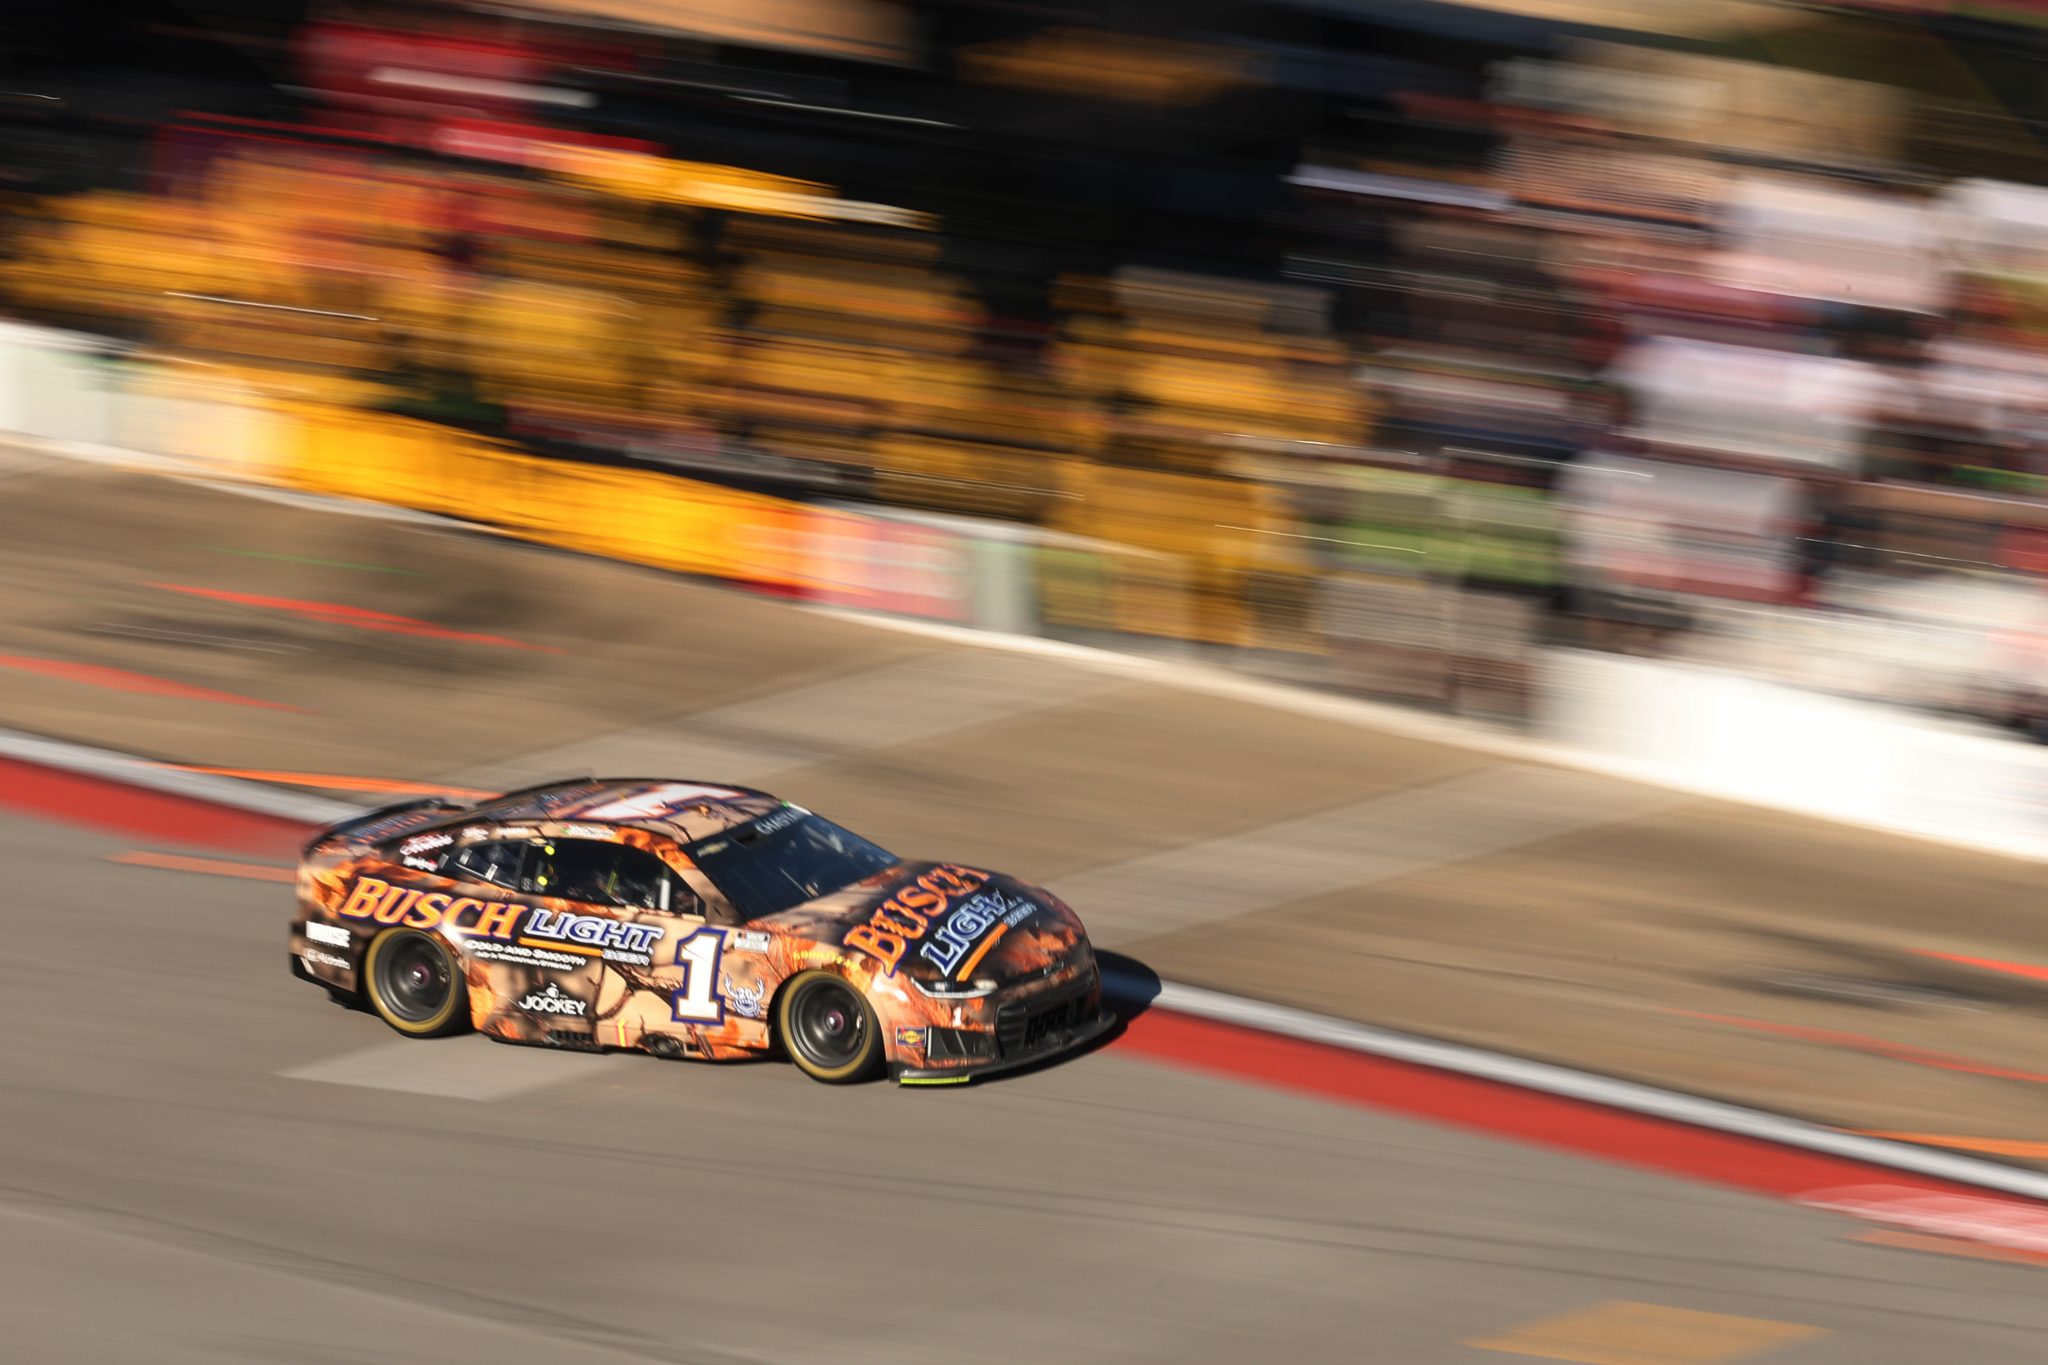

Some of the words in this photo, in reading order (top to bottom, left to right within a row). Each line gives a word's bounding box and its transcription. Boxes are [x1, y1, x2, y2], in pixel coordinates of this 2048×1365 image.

[339, 876, 528, 939] BUSCH
[523, 908, 665, 953] LIGHT
[504, 944, 533, 957] AND
[532, 949, 587, 966] SMOOTH
[673, 929, 726, 1024] 1
[518, 995, 587, 1015] JOCKEY
[952, 1006, 962, 1027] 1
